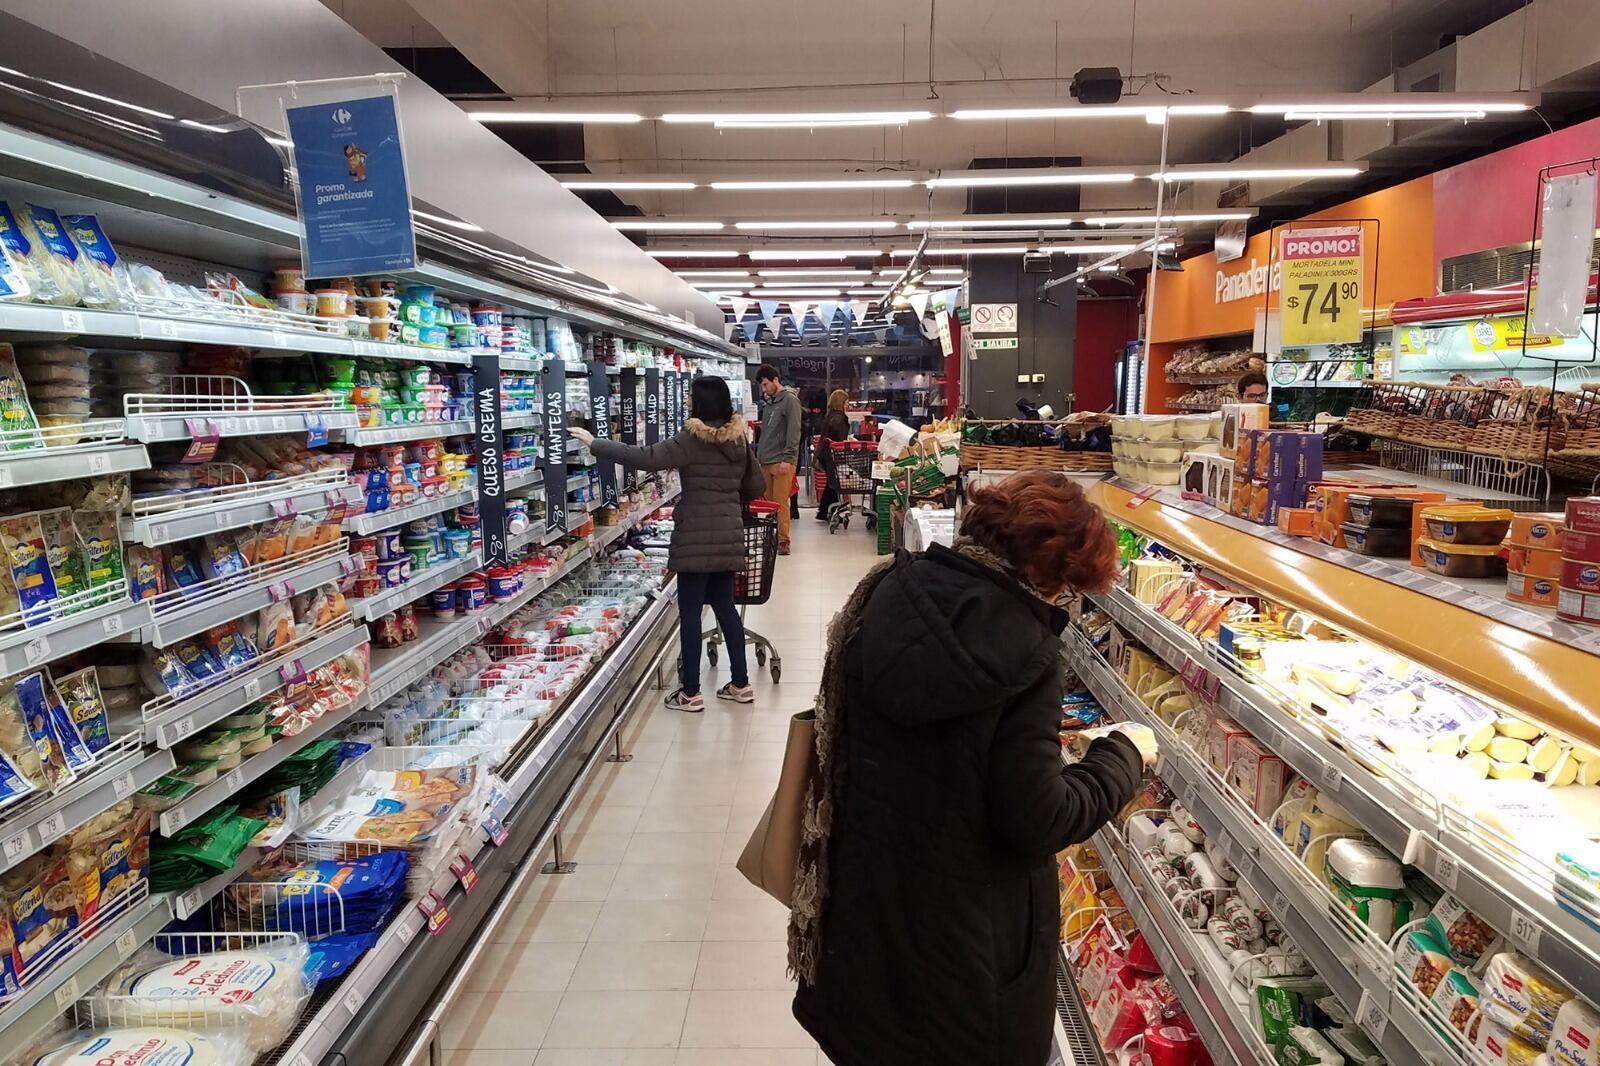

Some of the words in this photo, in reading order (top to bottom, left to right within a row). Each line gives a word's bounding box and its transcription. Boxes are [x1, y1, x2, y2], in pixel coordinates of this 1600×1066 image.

[315, 183, 345, 193] Promo
[317, 189, 373, 205] garantizada
[1287, 240, 1356, 256] PROMO!
[1292, 260, 1337, 268] MORTADELA
[478, 387, 496, 443] CREMA
[647, 393, 657, 424] SALUD
[666, 376, 674, 420] DESCREMADO
[547, 391, 563, 465] MANTECAS
[623, 397, 634, 434] LECHES
[483, 447, 500, 496] QUESO
